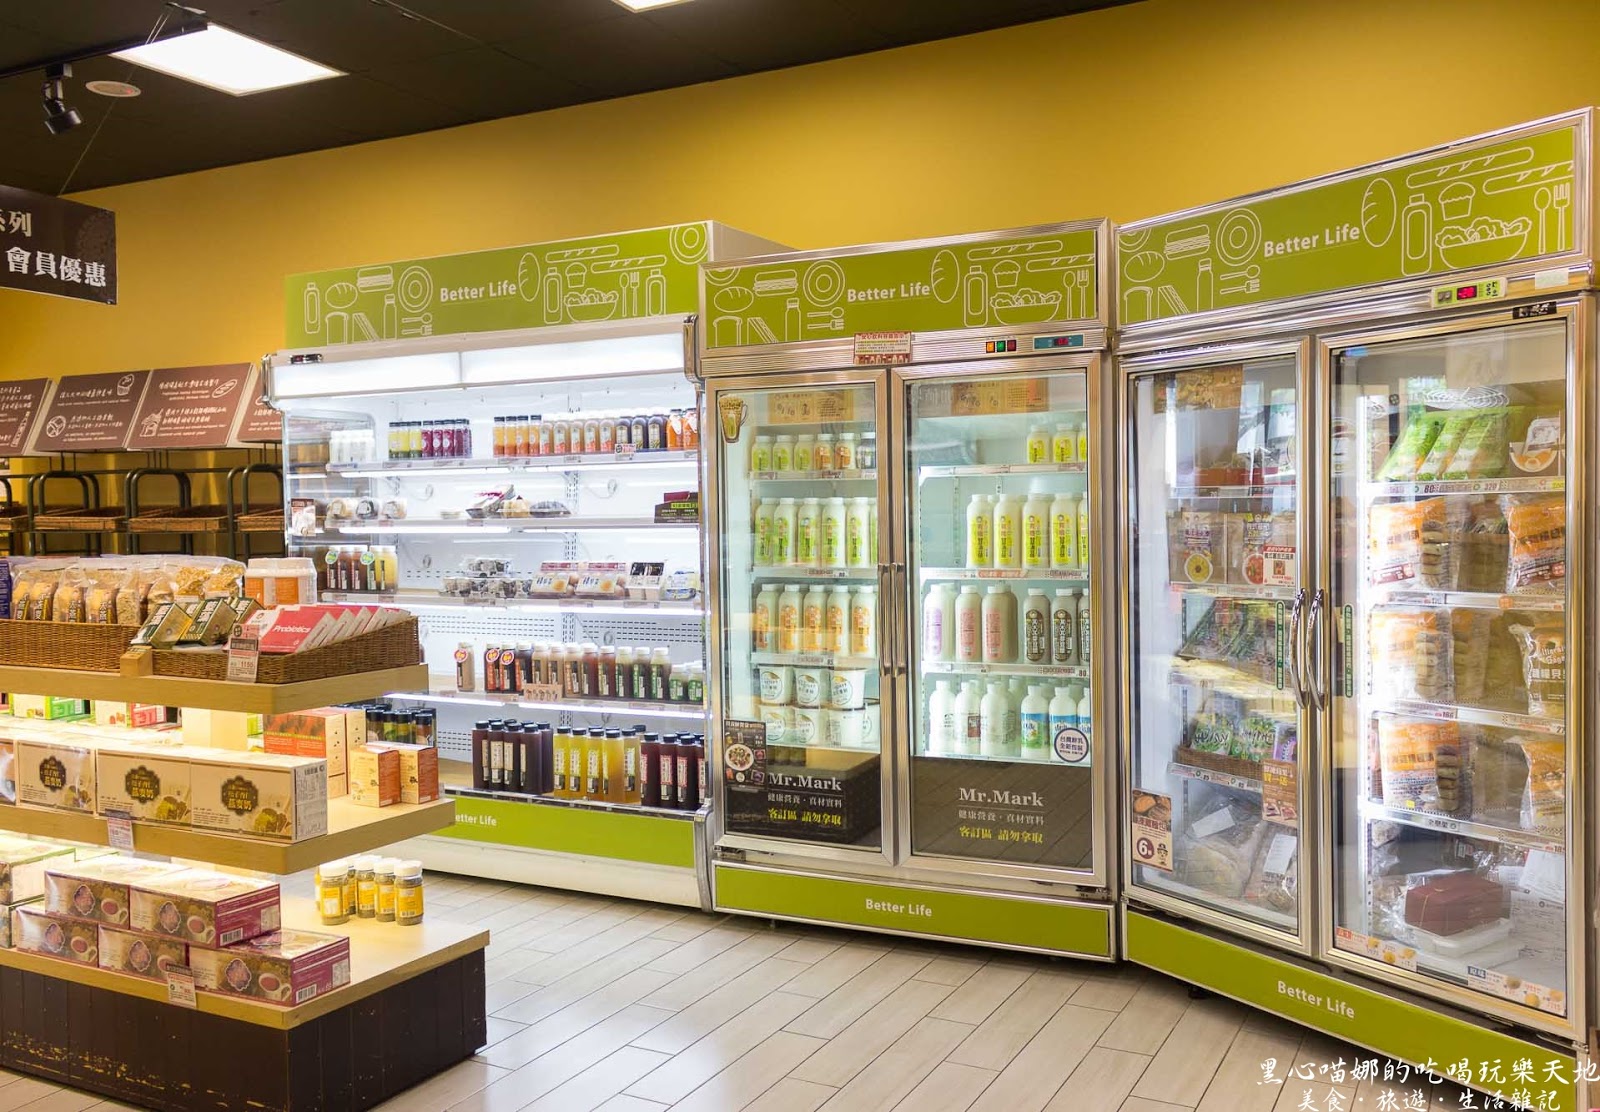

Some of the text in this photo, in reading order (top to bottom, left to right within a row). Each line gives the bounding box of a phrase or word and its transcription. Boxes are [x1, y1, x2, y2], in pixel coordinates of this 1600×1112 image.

[0, 209, 31, 238] 列
[1264, 223, 1361, 258] Better Life
[6, 246, 106, 288] 會員優惠
[440, 280, 517, 302] Better Life
[847, 282, 930, 303] Better Life
[272, 624, 311, 635] Probiotics
[768, 772, 842, 792] Mr.Mark
[959, 787, 1045, 807] Mr.Mark
[455, 813, 497, 827] etter Life
[768, 807, 842, 827] 客訂區 請勿拿取
[959, 825, 1044, 845] 客訂區 請勿拿取
[865, 898, 932, 917] Better Life
[1277, 980, 1356, 1019] Better Life
